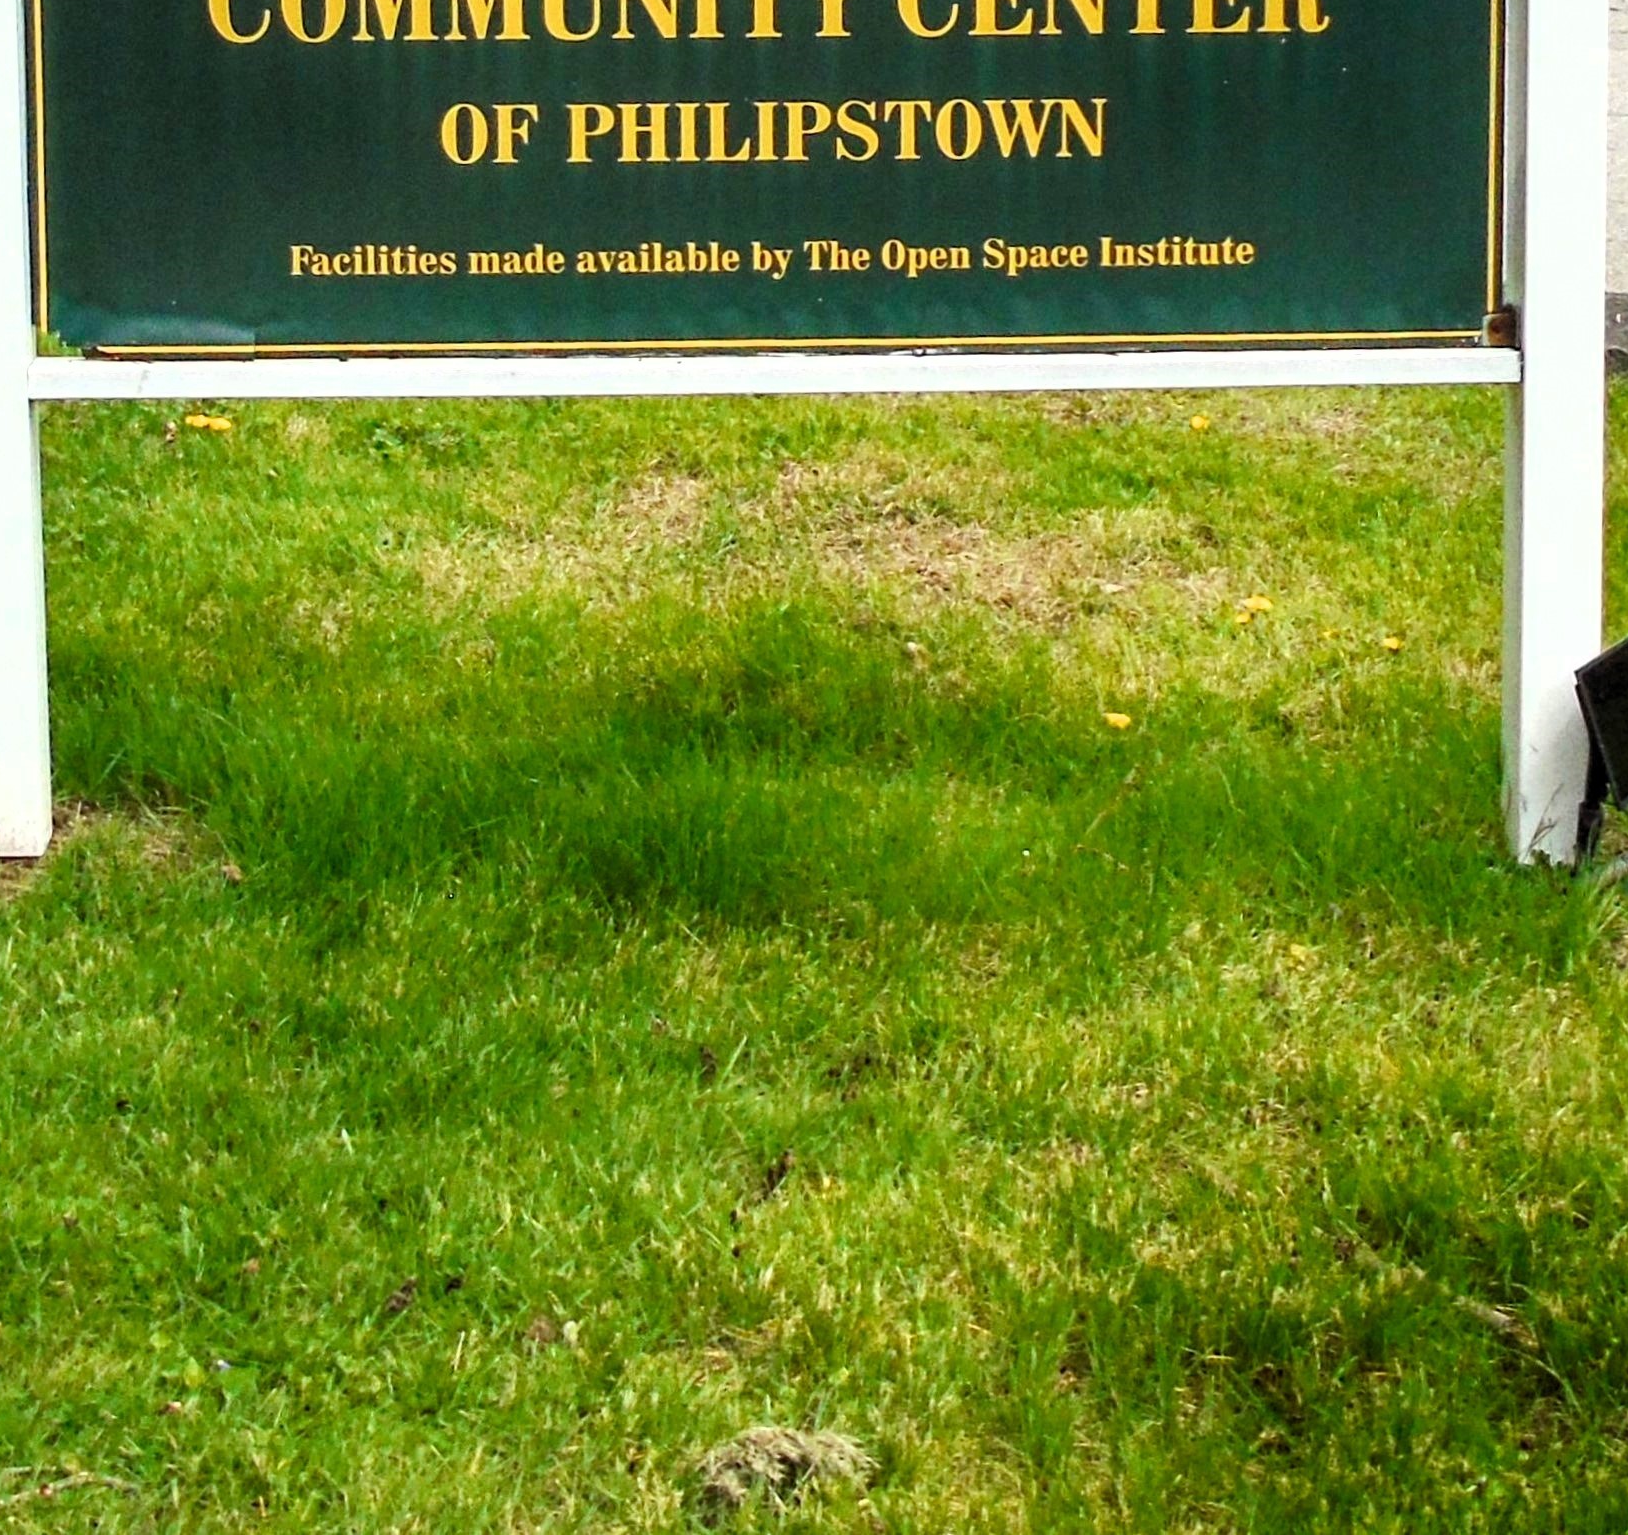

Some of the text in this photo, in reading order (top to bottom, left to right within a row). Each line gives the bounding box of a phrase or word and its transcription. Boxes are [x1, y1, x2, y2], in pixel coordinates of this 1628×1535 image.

[439, 98, 1108, 166] OF PHILIPSTOWN
[290, 236, 1256, 281] Facilities made available by The Open Space Institute
